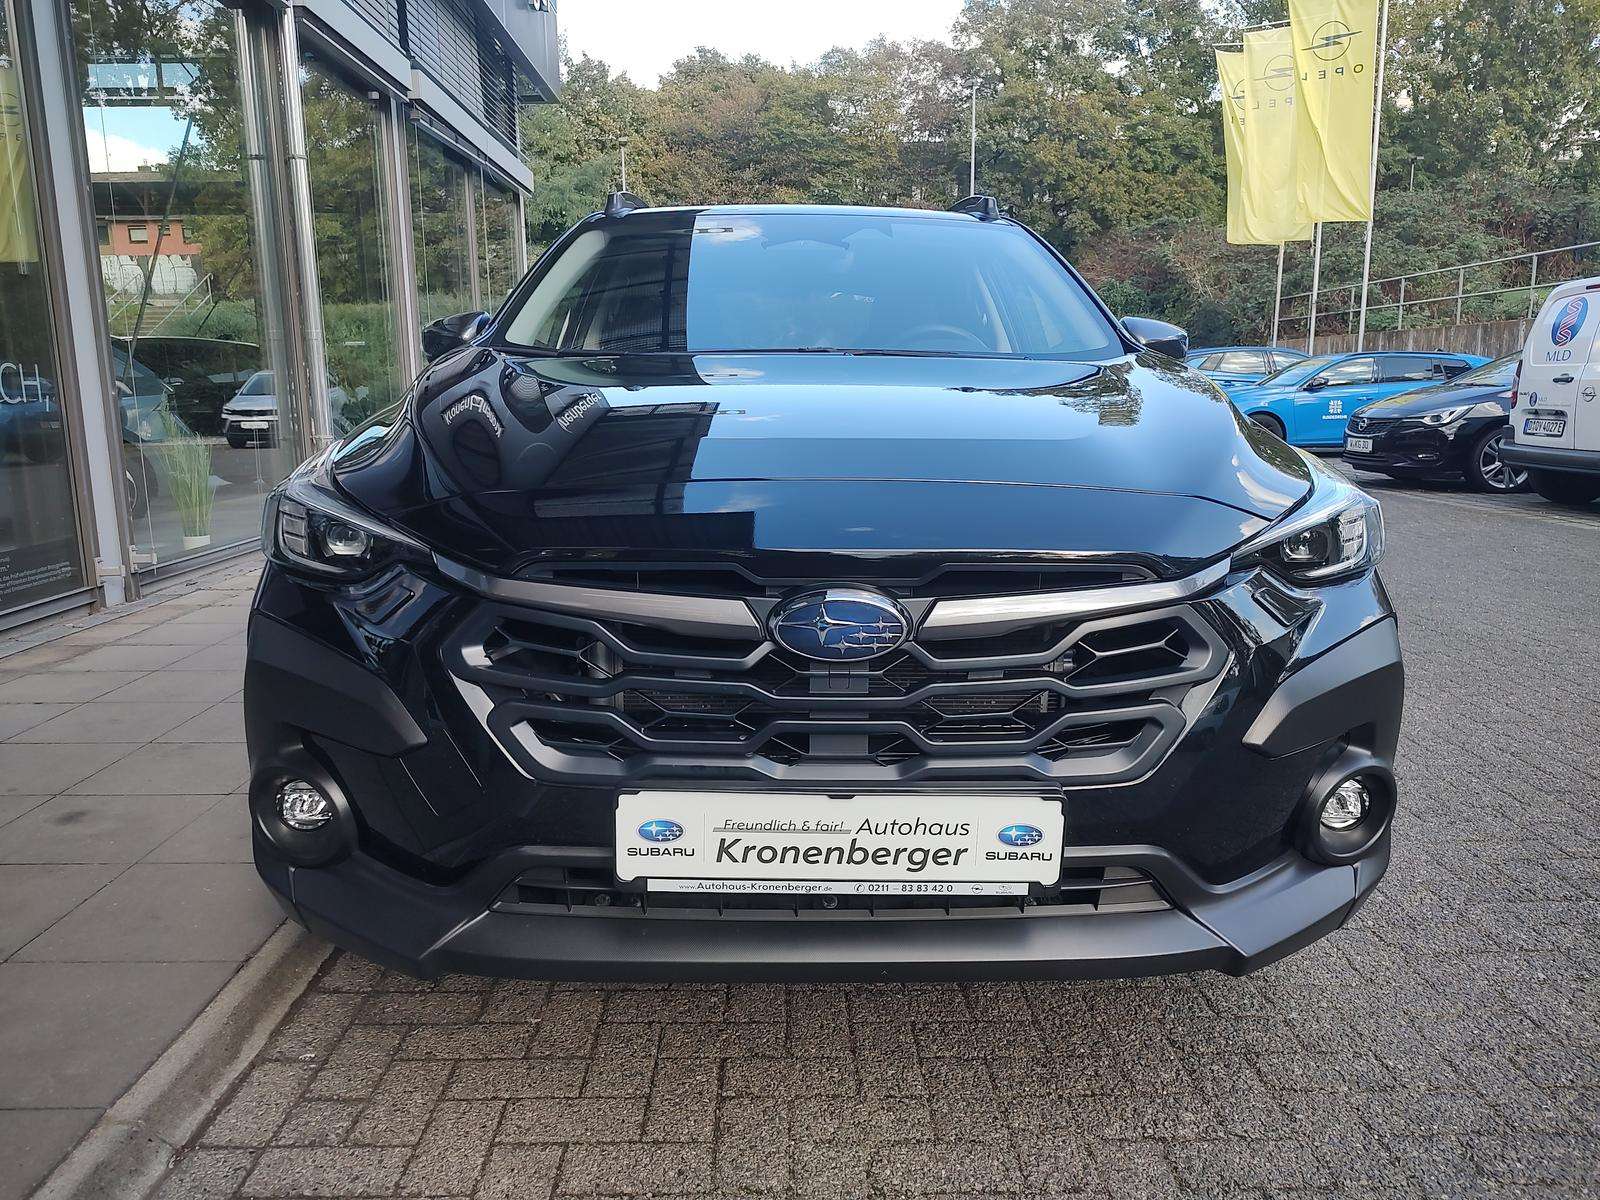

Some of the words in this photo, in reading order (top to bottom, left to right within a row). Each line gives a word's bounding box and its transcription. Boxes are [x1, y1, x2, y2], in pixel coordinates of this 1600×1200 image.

[1545, 349, 1571, 362] MLD
[723, 818, 797, 832] Freundlich
[801, 820, 811, 832] &
[815, 819, 845, 833] fair!
[855, 816, 971, 836] Autohaus
[627, 846, 695, 857] SUBARU
[715, 837, 969, 873] Kronenberger
[985, 851, 1053, 862] SUBARU
[678, 881, 833, 893] www.Autohaus-Kronenberger.de
[868, 883, 890, 892] 0211
[901, 883, 914, 892] 83
[916, 883, 929, 892] 83
[931, 883, 945, 892] 42
[946, 883, 953, 892] 0
